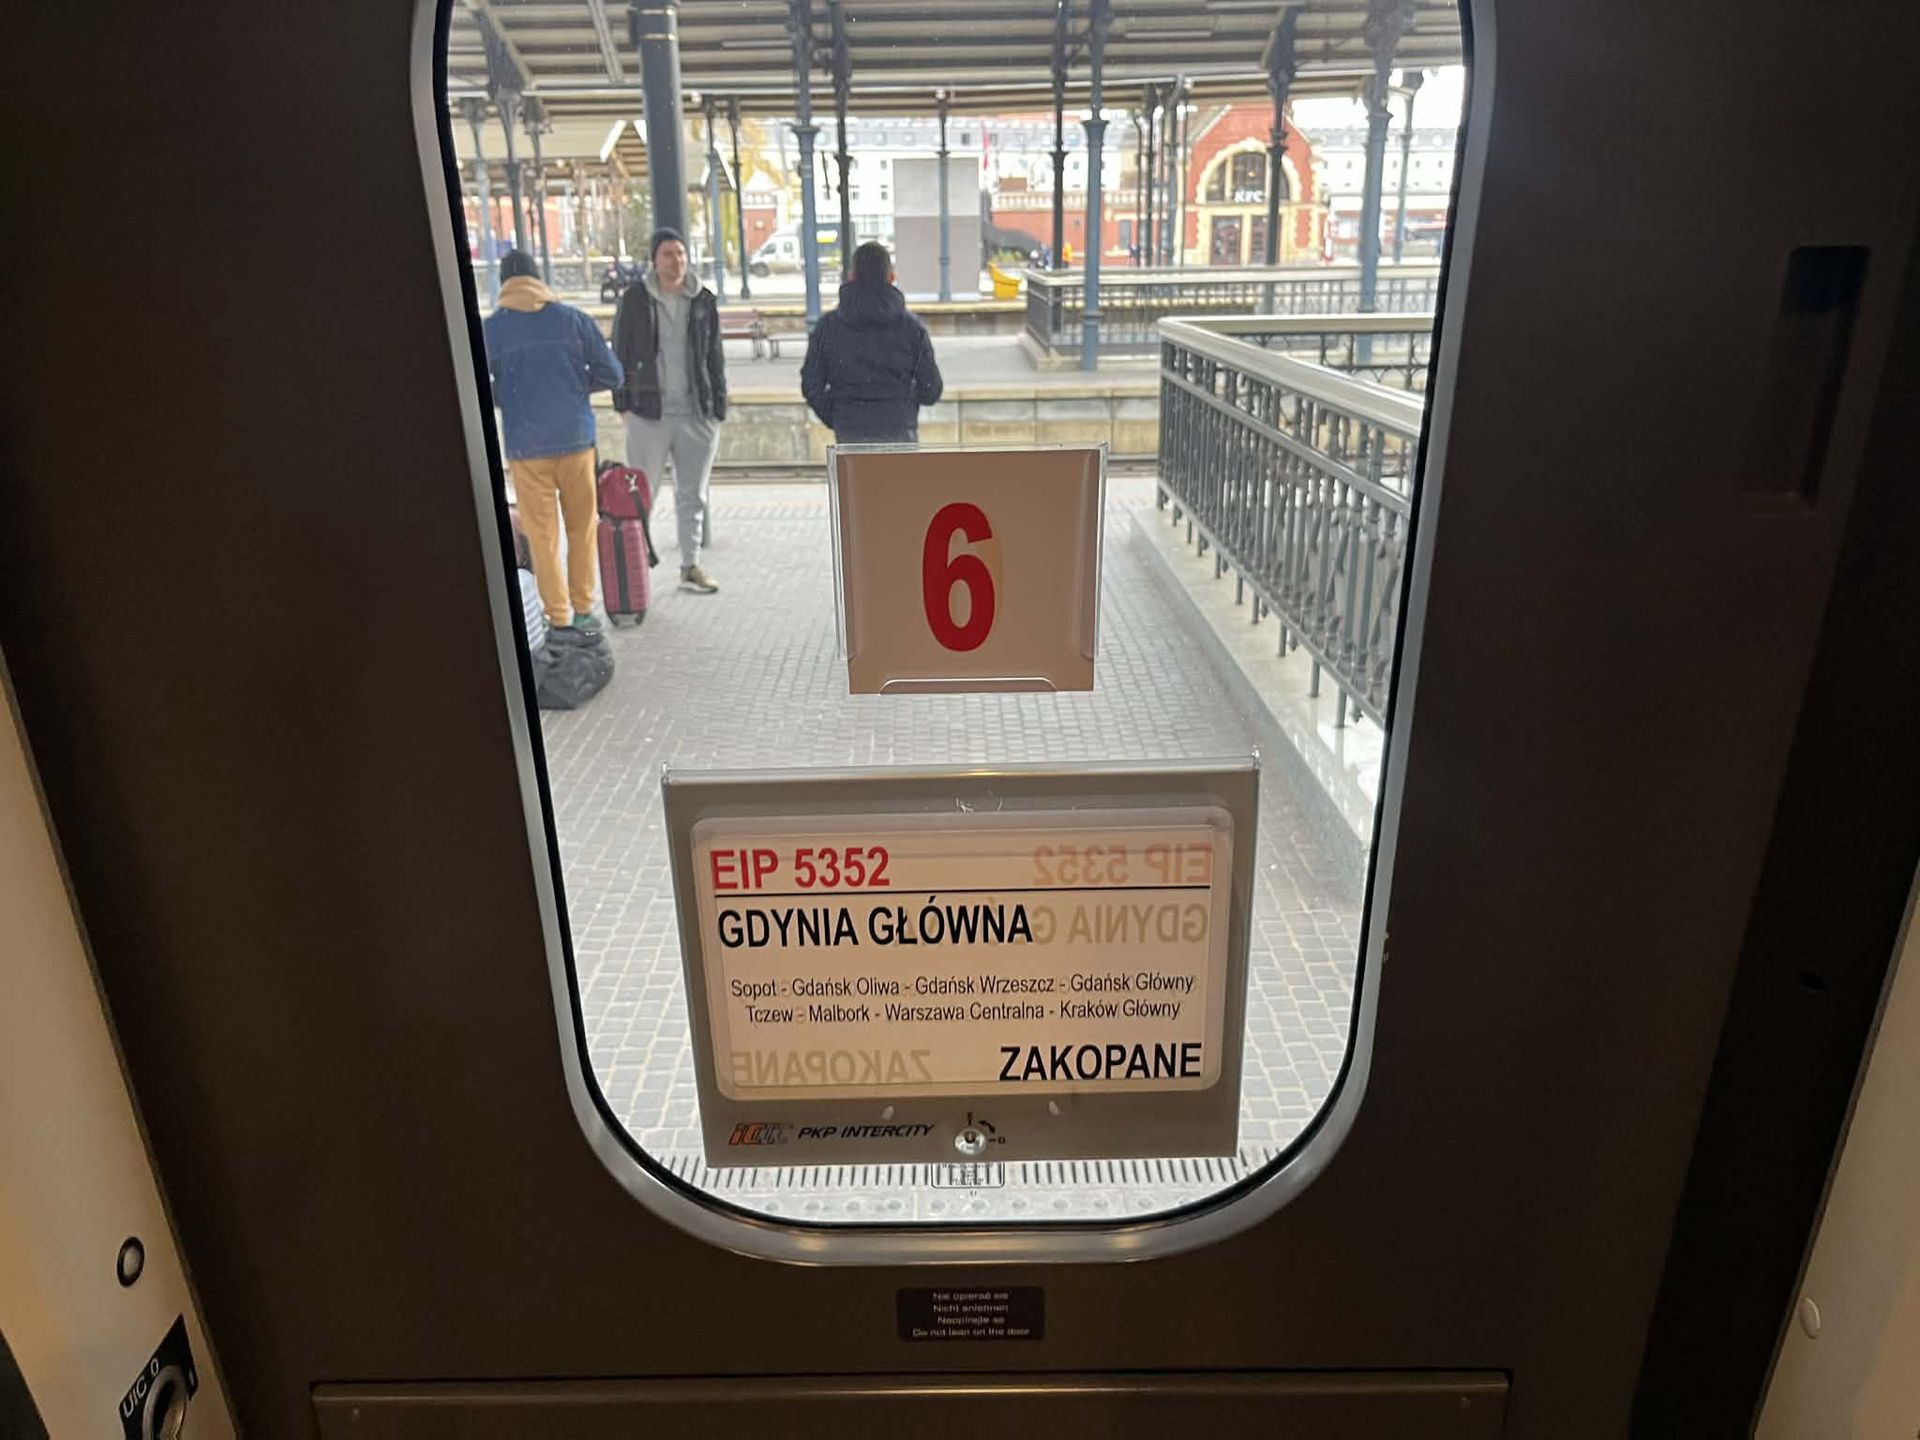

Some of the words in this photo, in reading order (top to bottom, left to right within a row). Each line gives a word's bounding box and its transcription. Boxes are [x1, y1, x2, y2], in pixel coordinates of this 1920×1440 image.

[1234, 190, 1265, 203] KFC
[922, 502, 996, 652] 6
[710, 848, 779, 889] EIP
[794, 846, 890, 888] 5352
[718, 908, 859, 948] GDYNIA
[868, 895, 1033, 945] GŁÓWNA
[731, 978, 777, 1000] Sopot
[792, 976, 851, 997] Gdańsk
[856, 976, 900, 996] Oliwa
[915, 975, 975, 995] Gdańsk
[980, 974, 1055, 993] Wrzeszcz
[1070, 973, 1130, 992] Gdańsk
[745, 1004, 793, 1023] Tczew
[808, 1004, 871, 1023] Malbork
[884, 1003, 965, 1022] Warszawa
[970, 1001, 1045, 1020] Centralna
[1060, 1000, 1118, 1019] Kraków
[999, 1042, 1202, 1081] ZAKOPANE
[798, 1125, 838, 1139] PKP
[841, 1124, 936, 1139] INTERCITY
[930, 1328, 946, 1336] not
[949, 1328, 970, 1336] lean
[973, 1328, 986, 1336] on
[989, 1327, 1004, 1336] the
[122, 1376, 147, 1418] UIC
